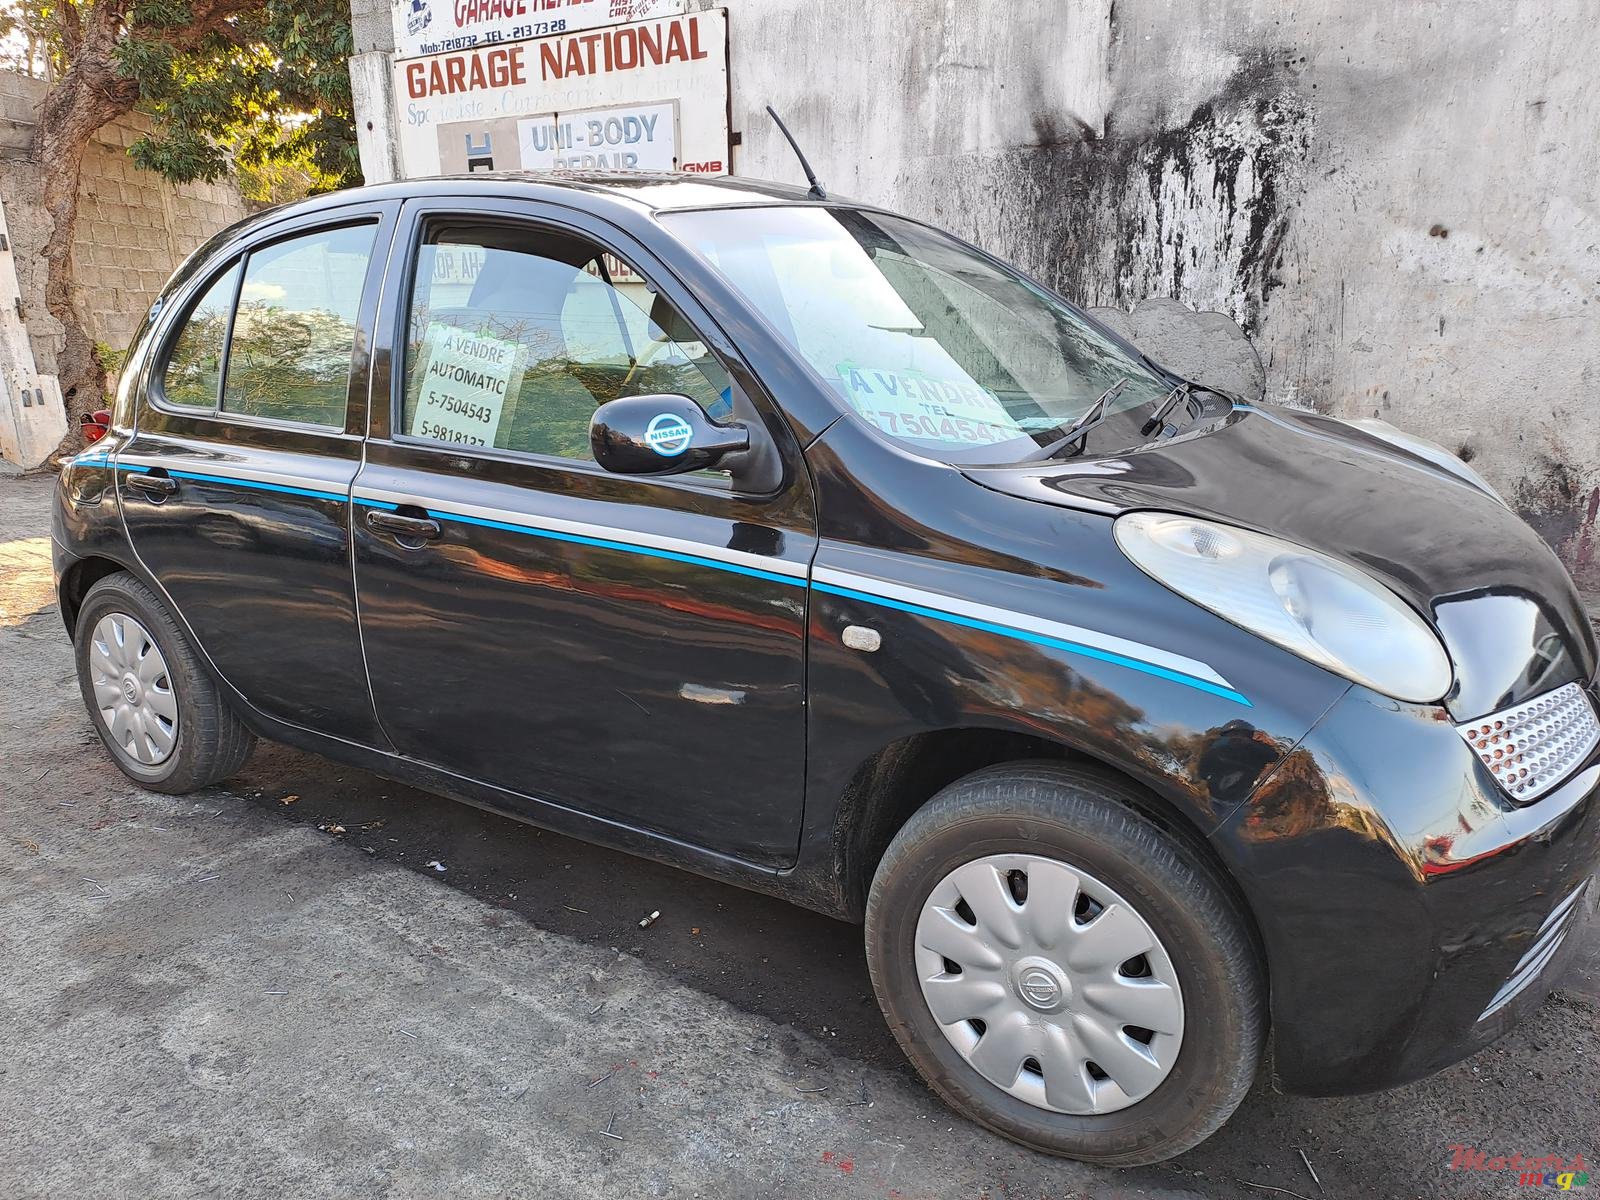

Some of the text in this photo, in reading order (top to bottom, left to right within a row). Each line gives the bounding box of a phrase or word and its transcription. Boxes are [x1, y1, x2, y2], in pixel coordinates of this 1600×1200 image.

[485, 30, 505, 43] TEL
[513, 25, 532, 38] 213
[535, 22, 549, 35] 73
[550, 19, 567, 32] 28
[406, 16, 708, 99] GARAGE NATIONAL
[682, 160, 723, 173] GMB
[443, 335, 505, 364] A VENDRE
[430, 360, 506, 395] AUTOMATIC
[850, 368, 875, 394] A
[427, 391, 492, 424] 5-7504543
[919, 402, 955, 418] TEL
[650, 427, 689, 441] NISSAN
